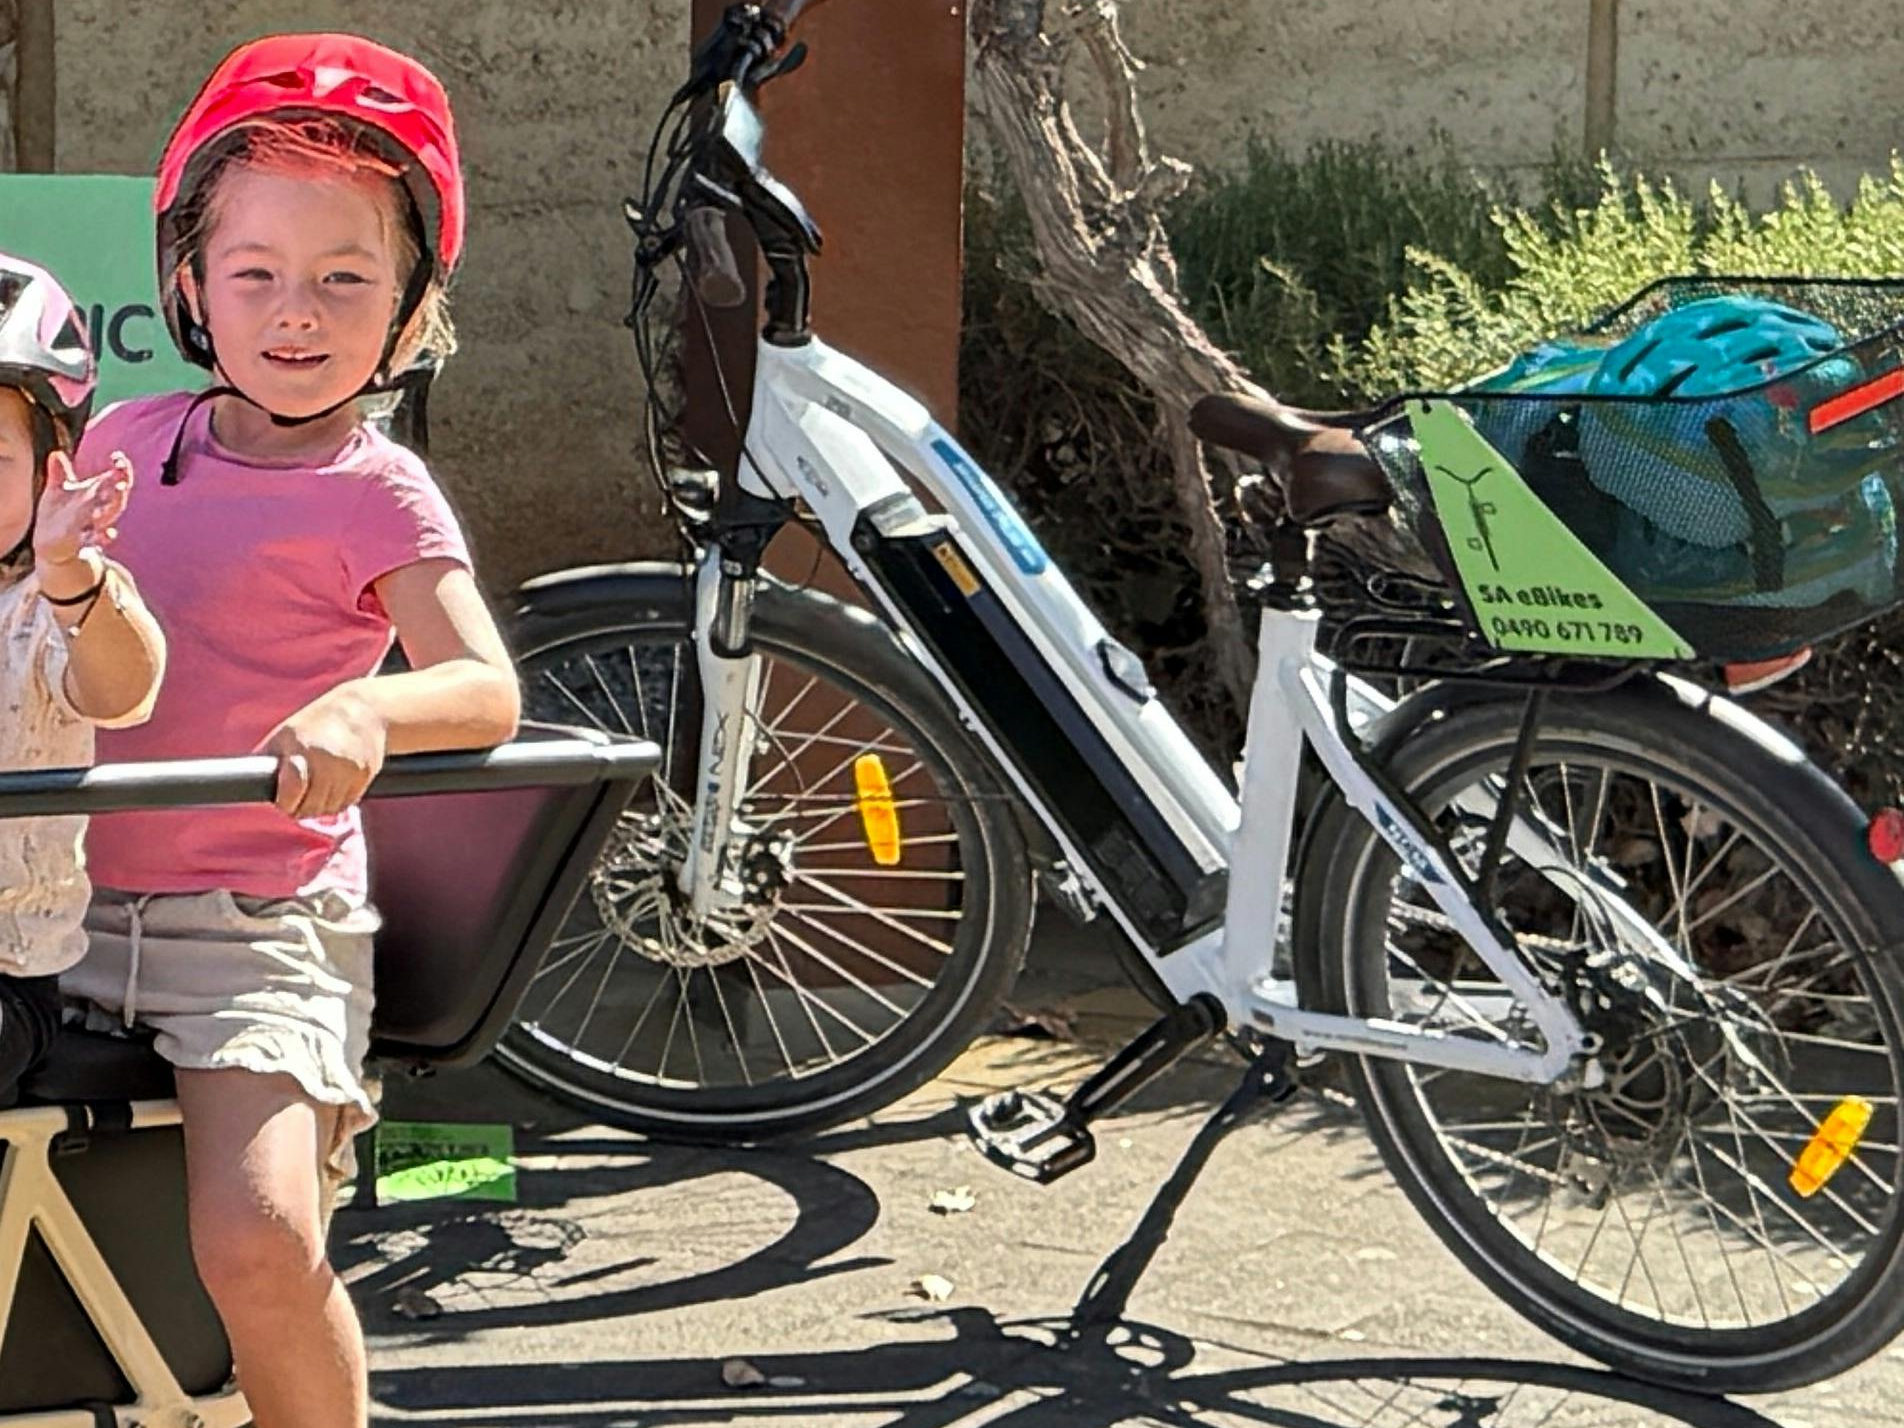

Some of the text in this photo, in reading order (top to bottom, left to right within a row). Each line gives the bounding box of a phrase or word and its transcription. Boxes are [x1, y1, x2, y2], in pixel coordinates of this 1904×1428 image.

[89, 303, 155, 364] IC
[1478, 583, 1604, 610] SA eBikes
[1491, 616, 1644, 645] 0490 671 789
